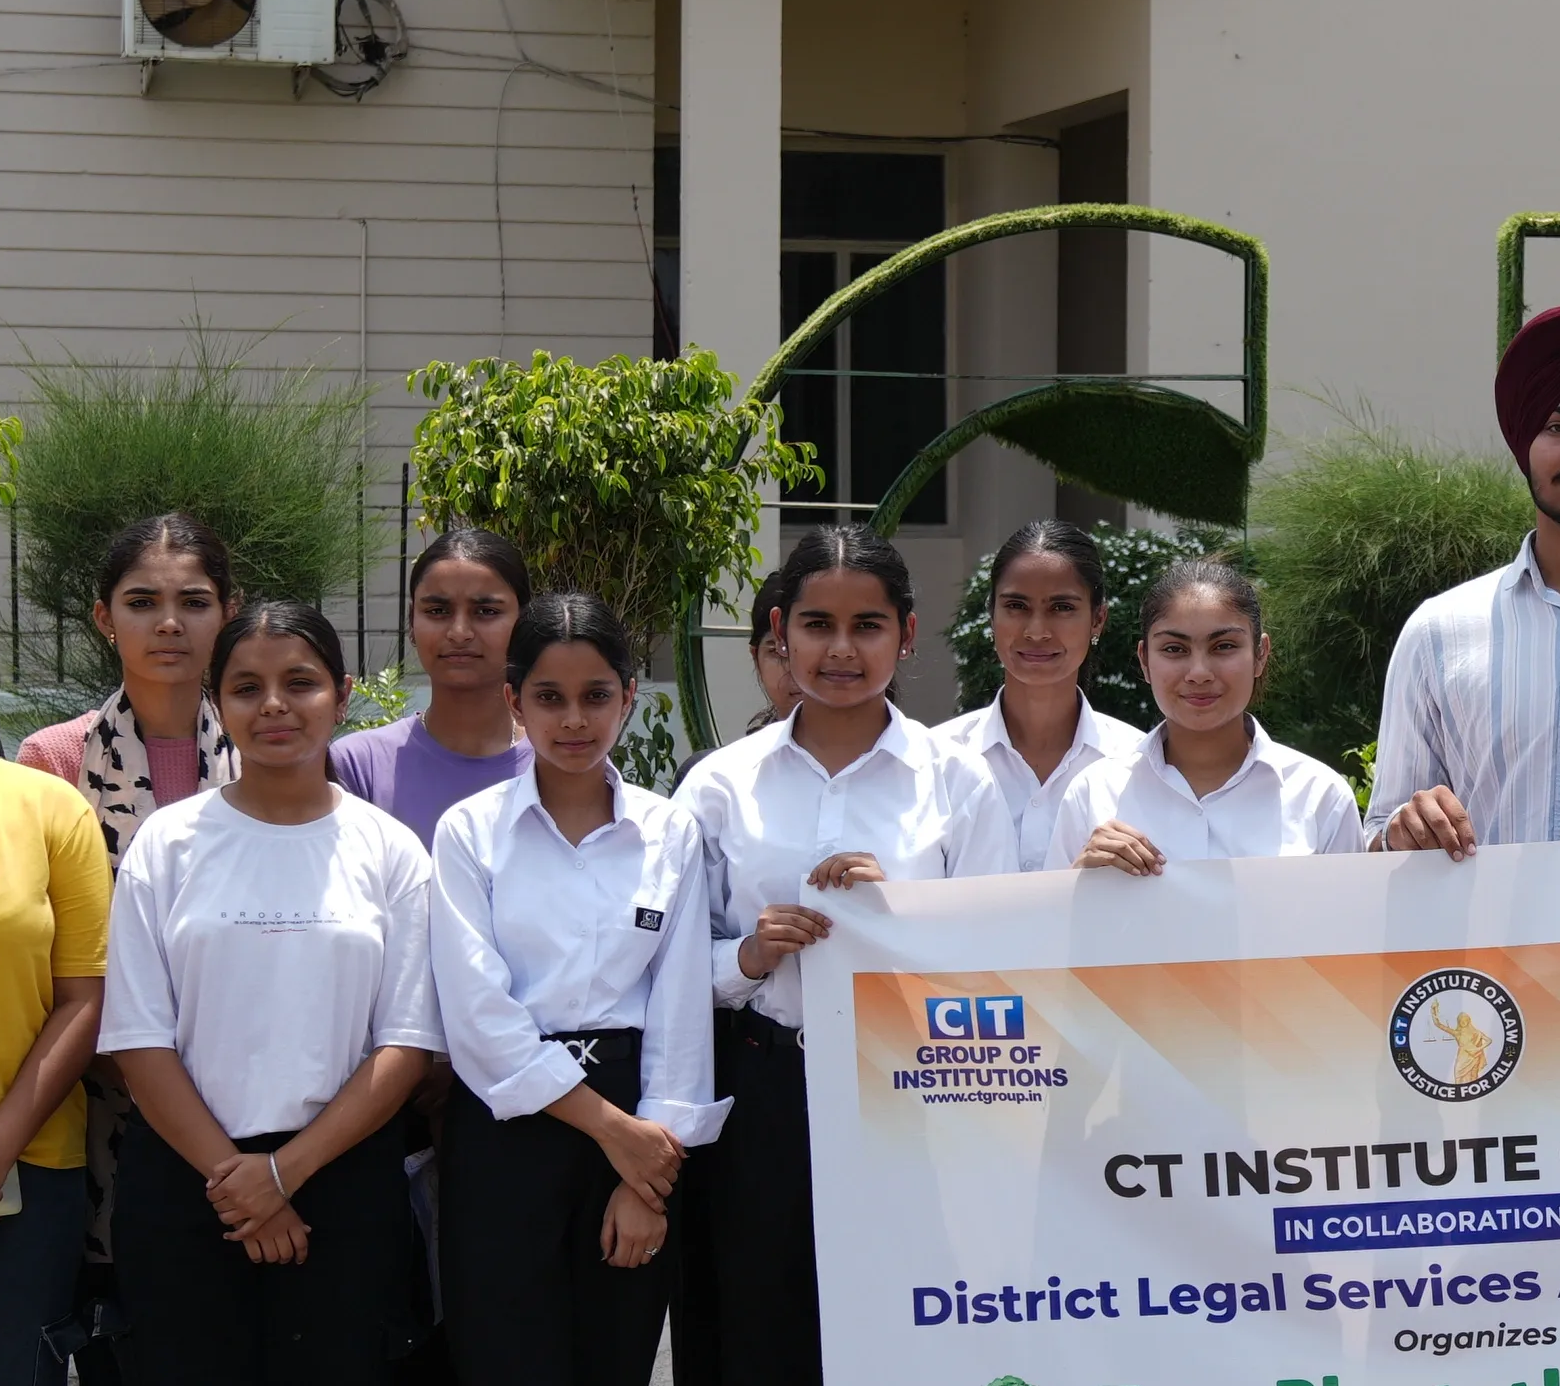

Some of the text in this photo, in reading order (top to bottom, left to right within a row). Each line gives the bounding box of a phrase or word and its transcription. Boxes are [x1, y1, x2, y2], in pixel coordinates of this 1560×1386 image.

[935, 1000, 1014, 1036] CT
[1394, 975, 1518, 1045] CT INSTITUTE OF LAW
[916, 1046, 1041, 1065] GROUP OF
[893, 1068, 1068, 1090] INSTITUTIONS
[1402, 1060, 1513, 1098] JUSTICE FOR ALL
[922, 1090, 1042, 1104] www.ctgroup.in
[1104, 1153, 1183, 1200] CT
[1204, 1134, 1540, 1197] INSTITUTE
[1284, 1218, 1313, 1242] IN
[912, 1276, 1119, 1327] District
[1138, 1273, 1286, 1324] Legal
[1303, 1263, 1541, 1312] Services
[1394, 1323, 1558, 1356] Organizes
